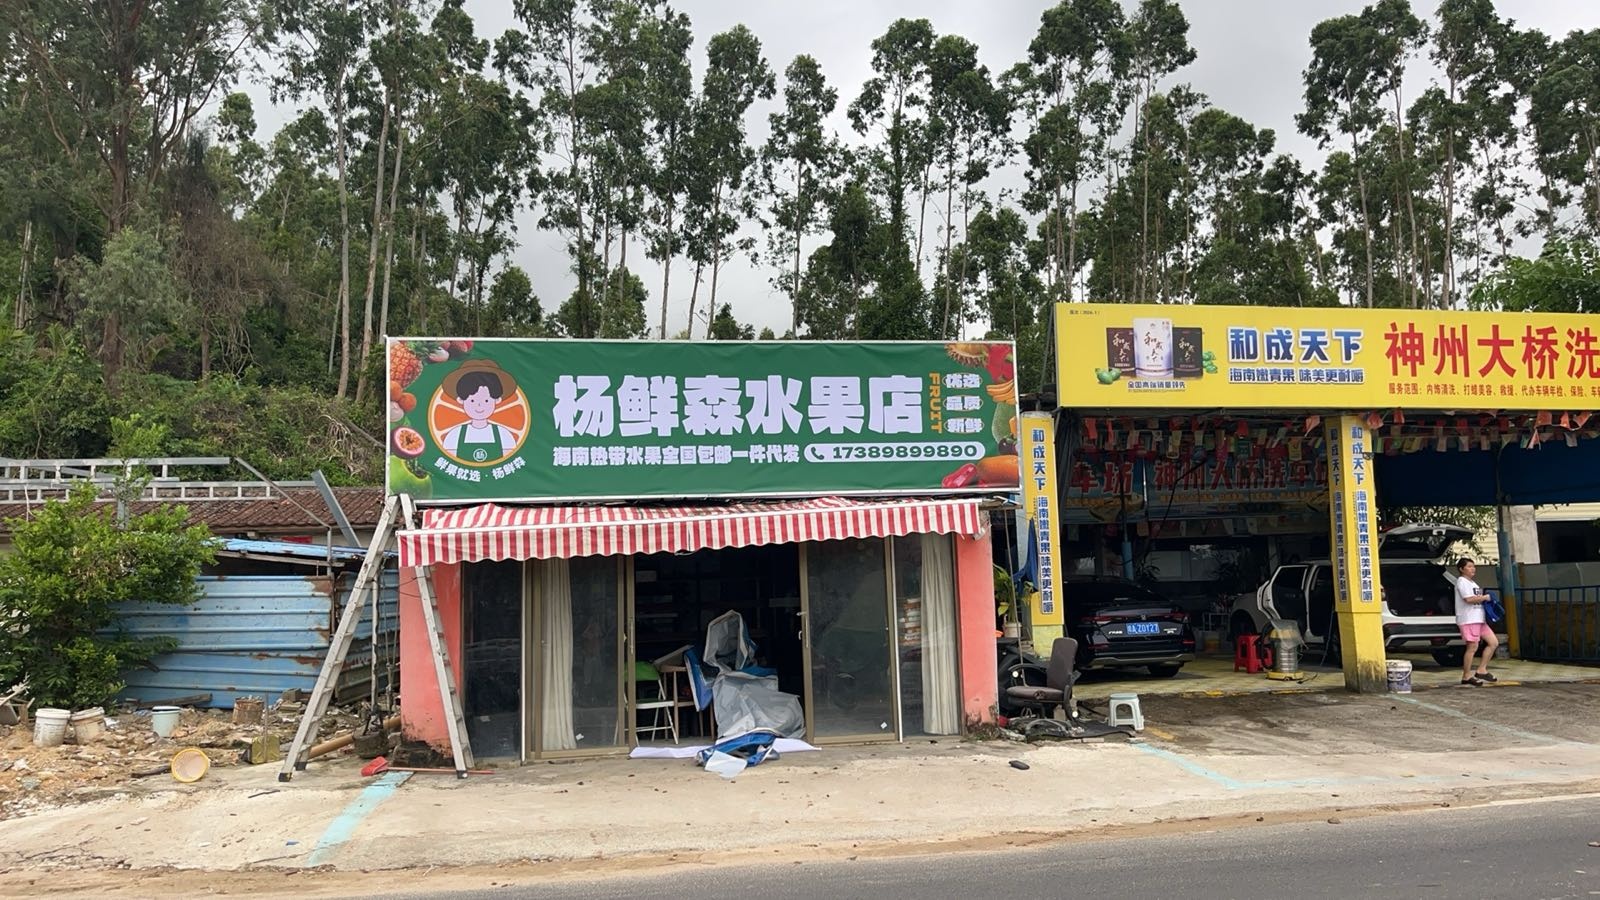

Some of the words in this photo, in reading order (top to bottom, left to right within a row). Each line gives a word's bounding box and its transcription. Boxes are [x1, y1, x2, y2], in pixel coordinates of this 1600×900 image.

[1228, 326, 1364, 364] 和成天下
[1384, 321, 1600, 380] 神州大桥洗
[1229, 367, 1295, 383] 海南嫩青果
[1298, 368, 1365, 384] 味美更耐嚼
[553, 375, 923, 438] 杨鲜森水果店
[929, 373, 942, 434] FRUIT
[434, 456, 481, 482] 鲜果就选
[553, 444, 800, 467] 海南热带水果全国包邮一件代发
[833, 445, 977, 459] 17389899890
[1032, 429, 1047, 491] 和成天下
[1351, 426, 1364, 485] 和成天下
